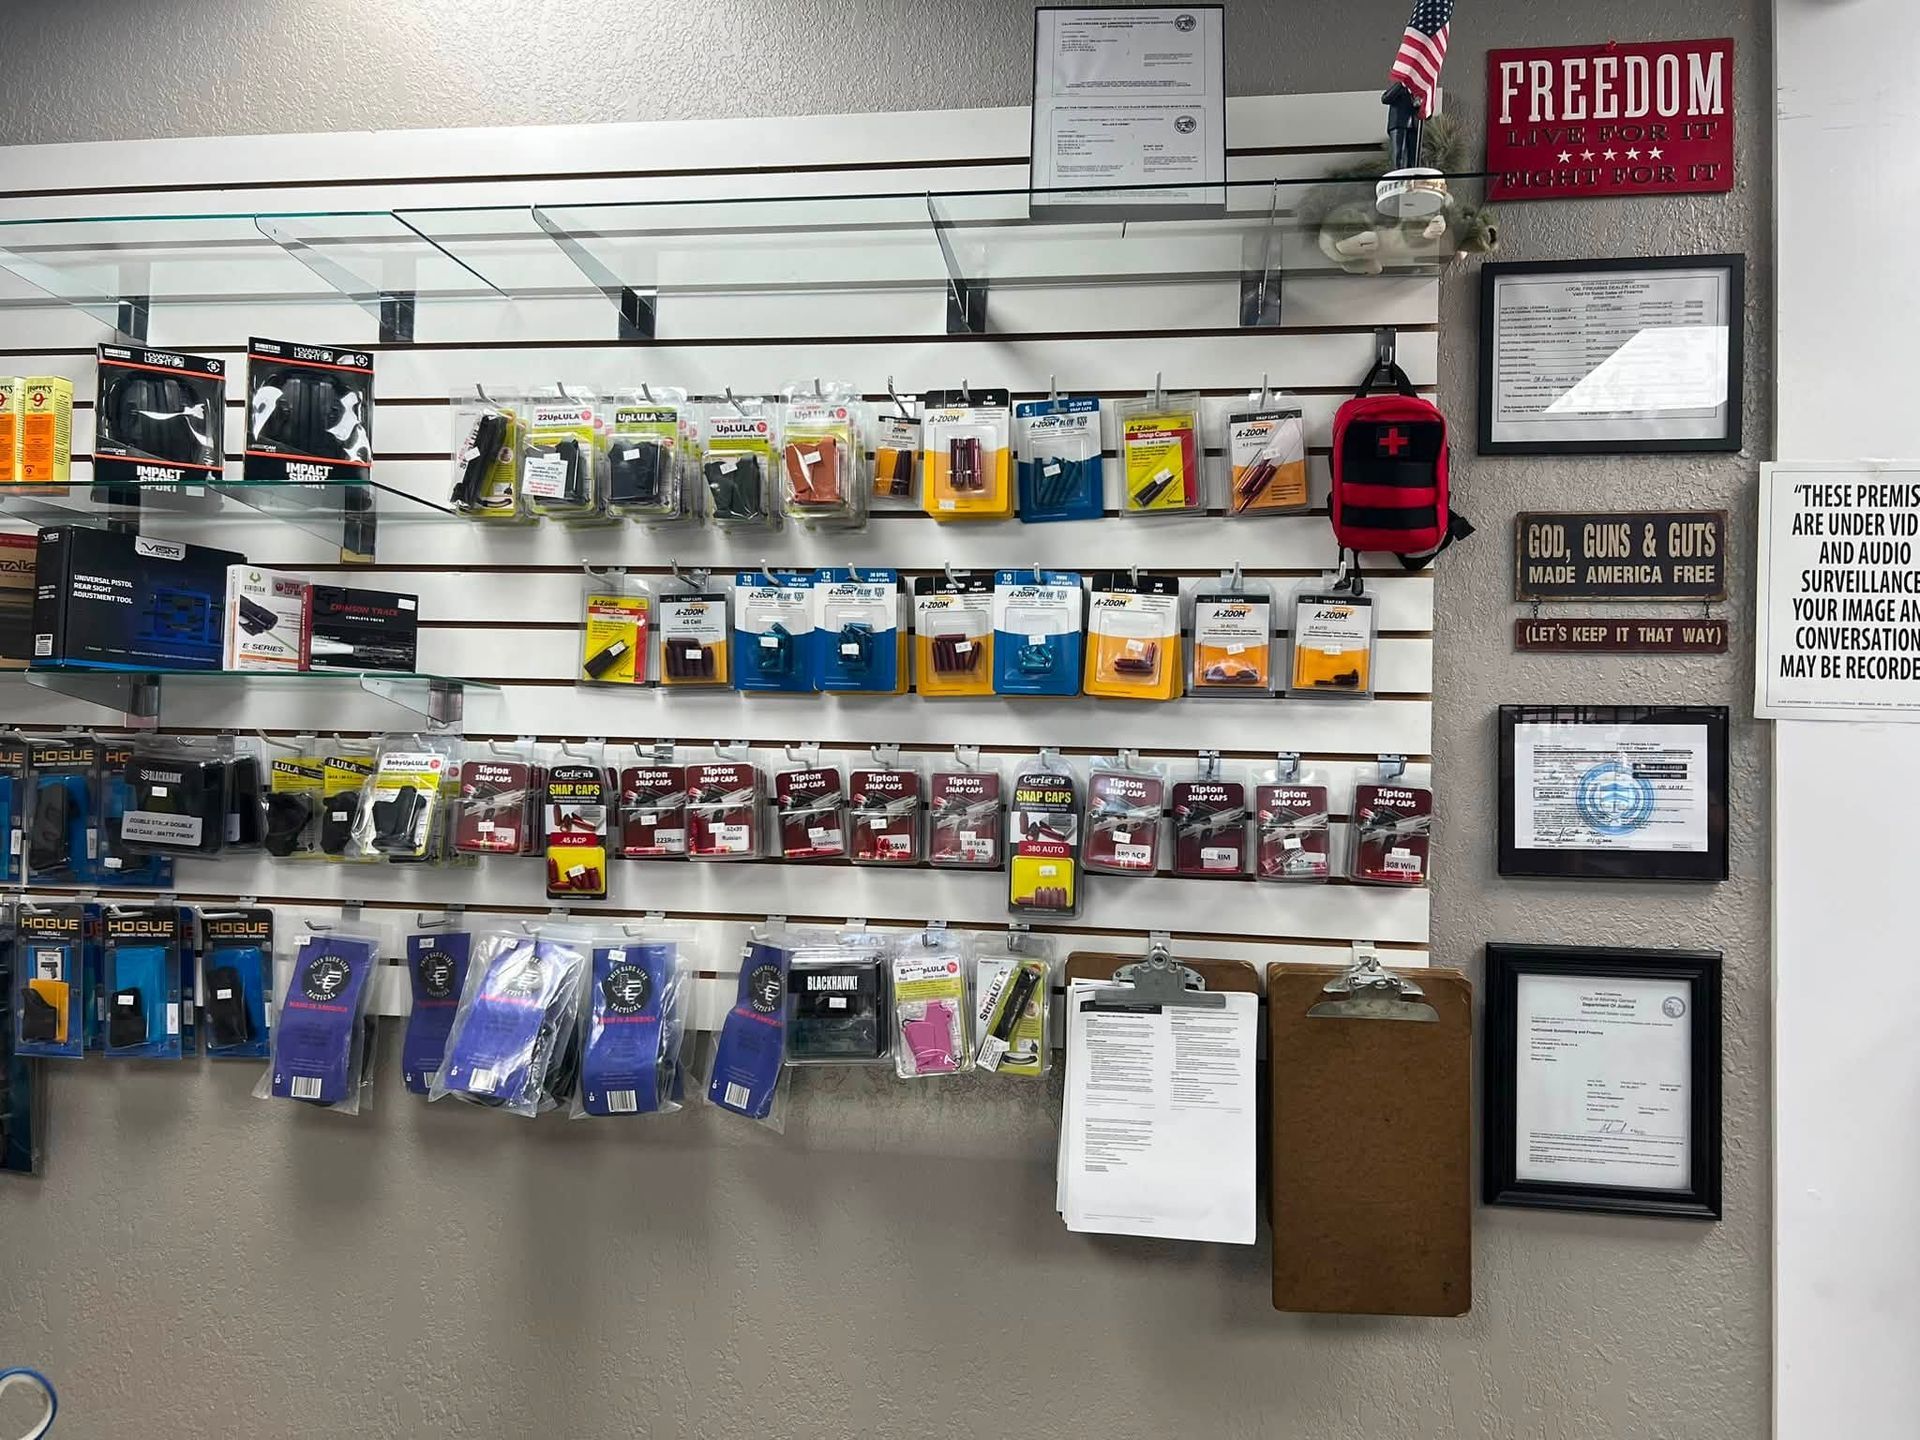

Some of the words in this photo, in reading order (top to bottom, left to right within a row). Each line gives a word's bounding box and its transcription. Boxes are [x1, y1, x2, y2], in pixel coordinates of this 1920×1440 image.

[1500, 52, 1724, 124] FREEDOM
[1507, 127, 1586, 147] LIVE
[1599, 123, 1670, 143] FOR
[1680, 121, 1718, 141] IT
[1503, 167, 1603, 189] FIGHT
[1612, 165, 1677, 185] FOR
[1688, 162, 1722, 182] IT
[537, 414, 579, 422] 22UpLULA
[618, 413, 656, 422] UpLULA
[928, 414, 960, 423] A-ZOOM
[716, 424, 755, 434] UpLULA
[1236, 428, 1268, 438] A-ZOOM
[137, 465, 185, 479] IMPACT
[286, 462, 333, 476] IMPACT
[1792, 513, 1824, 536] ARE
[1829, 513, 1884, 536] UNDER
[1890, 514, 1918, 536] VID
[1528, 524, 1571, 564] GOD,
[1584, 523, 1631, 558] GUNS
[1642, 522, 1656, 558] &
[1668, 522, 1716, 558] GUTS
[1819, 542, 1854, 564] AND
[1858, 542, 1912, 565] AUDIO
[1529, 566, 1576, 584] MADE
[1586, 566, 1663, 584] AMERICA
[1674, 565, 1715, 583] FREE
[74, 574, 110, 585] UNIVERSAL
[111, 579, 134, 588] PISTOL
[1801, 570, 1920, 594] SURVEILLANCE
[74, 582, 92, 591] REAR
[92, 584, 112, 593] SIGHT
[856, 588, 872, 596] BLUE
[73, 590, 116, 602] ADJUSTMENT
[116, 596, 134, 604] TOOL
[1038, 592, 1054, 600] BLUE
[330, 603, 369, 614] CRIMSON
[372, 606, 399, 616] TRACE
[920, 600, 949, 608] A-ZOOM
[675, 608, 704, 616] A-ZOOM
[1214, 610, 1246, 618] A-ZOOM
[1314, 611, 1348, 620] A-ZOOM
[1792, 598, 1838, 621] YOUR
[1842, 599, 1896, 622] IMAGE
[1526, 624, 1568, 643] (LET'S
[1572, 627, 1608, 642] KEEP
[1616, 627, 1630, 642] IT
[1638, 627, 1674, 642] THAT
[1682, 626, 1722, 645] WAY)
[1796, 626, 1920, 651] CONVERSATION
[252, 644, 284, 652] SERIES
[1780, 655, 1816, 678] MAY
[1821, 656, 1841, 678] BE
[34, 750, 94, 762] HOGUE
[275, 762, 300, 774] LULA
[330, 758, 356, 772] LULA
[478, 765, 509, 775] Tipton
[637, 770, 668, 780] Tipton
[702, 767, 735, 776] Tipton
[475, 774, 494, 782] SNAP
[700, 776, 720, 784] SNAP
[790, 773, 822, 782] Tipton
[868, 774, 899, 783] Tipton
[948, 777, 980, 787] Tipton
[1110, 778, 1143, 790] Tipton
[1190, 785, 1224, 794] Tipton
[550, 784, 573, 796] SNAP
[575, 784, 600, 796] CAPS
[1106, 788, 1126, 796] SNAP
[1128, 789, 1146, 798] CAPS
[1274, 790, 1308, 798] Tipton
[1377, 788, 1412, 798] Tipton
[1016, 790, 1042, 802] SNAP
[1044, 790, 1072, 804] CAPS
[1188, 794, 1208, 802] SNAP
[1209, 794, 1228, 802] CAPS
[1374, 798, 1395, 807] SNAP
[1396, 800, 1416, 808] CAPS
[1042, 846, 1064, 854] AUTO
[1386, 860, 1400, 868] 308
[1400, 861, 1416, 870] Win
[22, 917, 80, 930] HOGUE
[108, 921, 174, 932] HOGUE
[208, 922, 268, 934] HOGUE
[807, 976, 858, 991] BLACKHAWK!
[305, 990, 336, 1001] TACTICAL
[611, 1002, 642, 1014] TACTICAL
